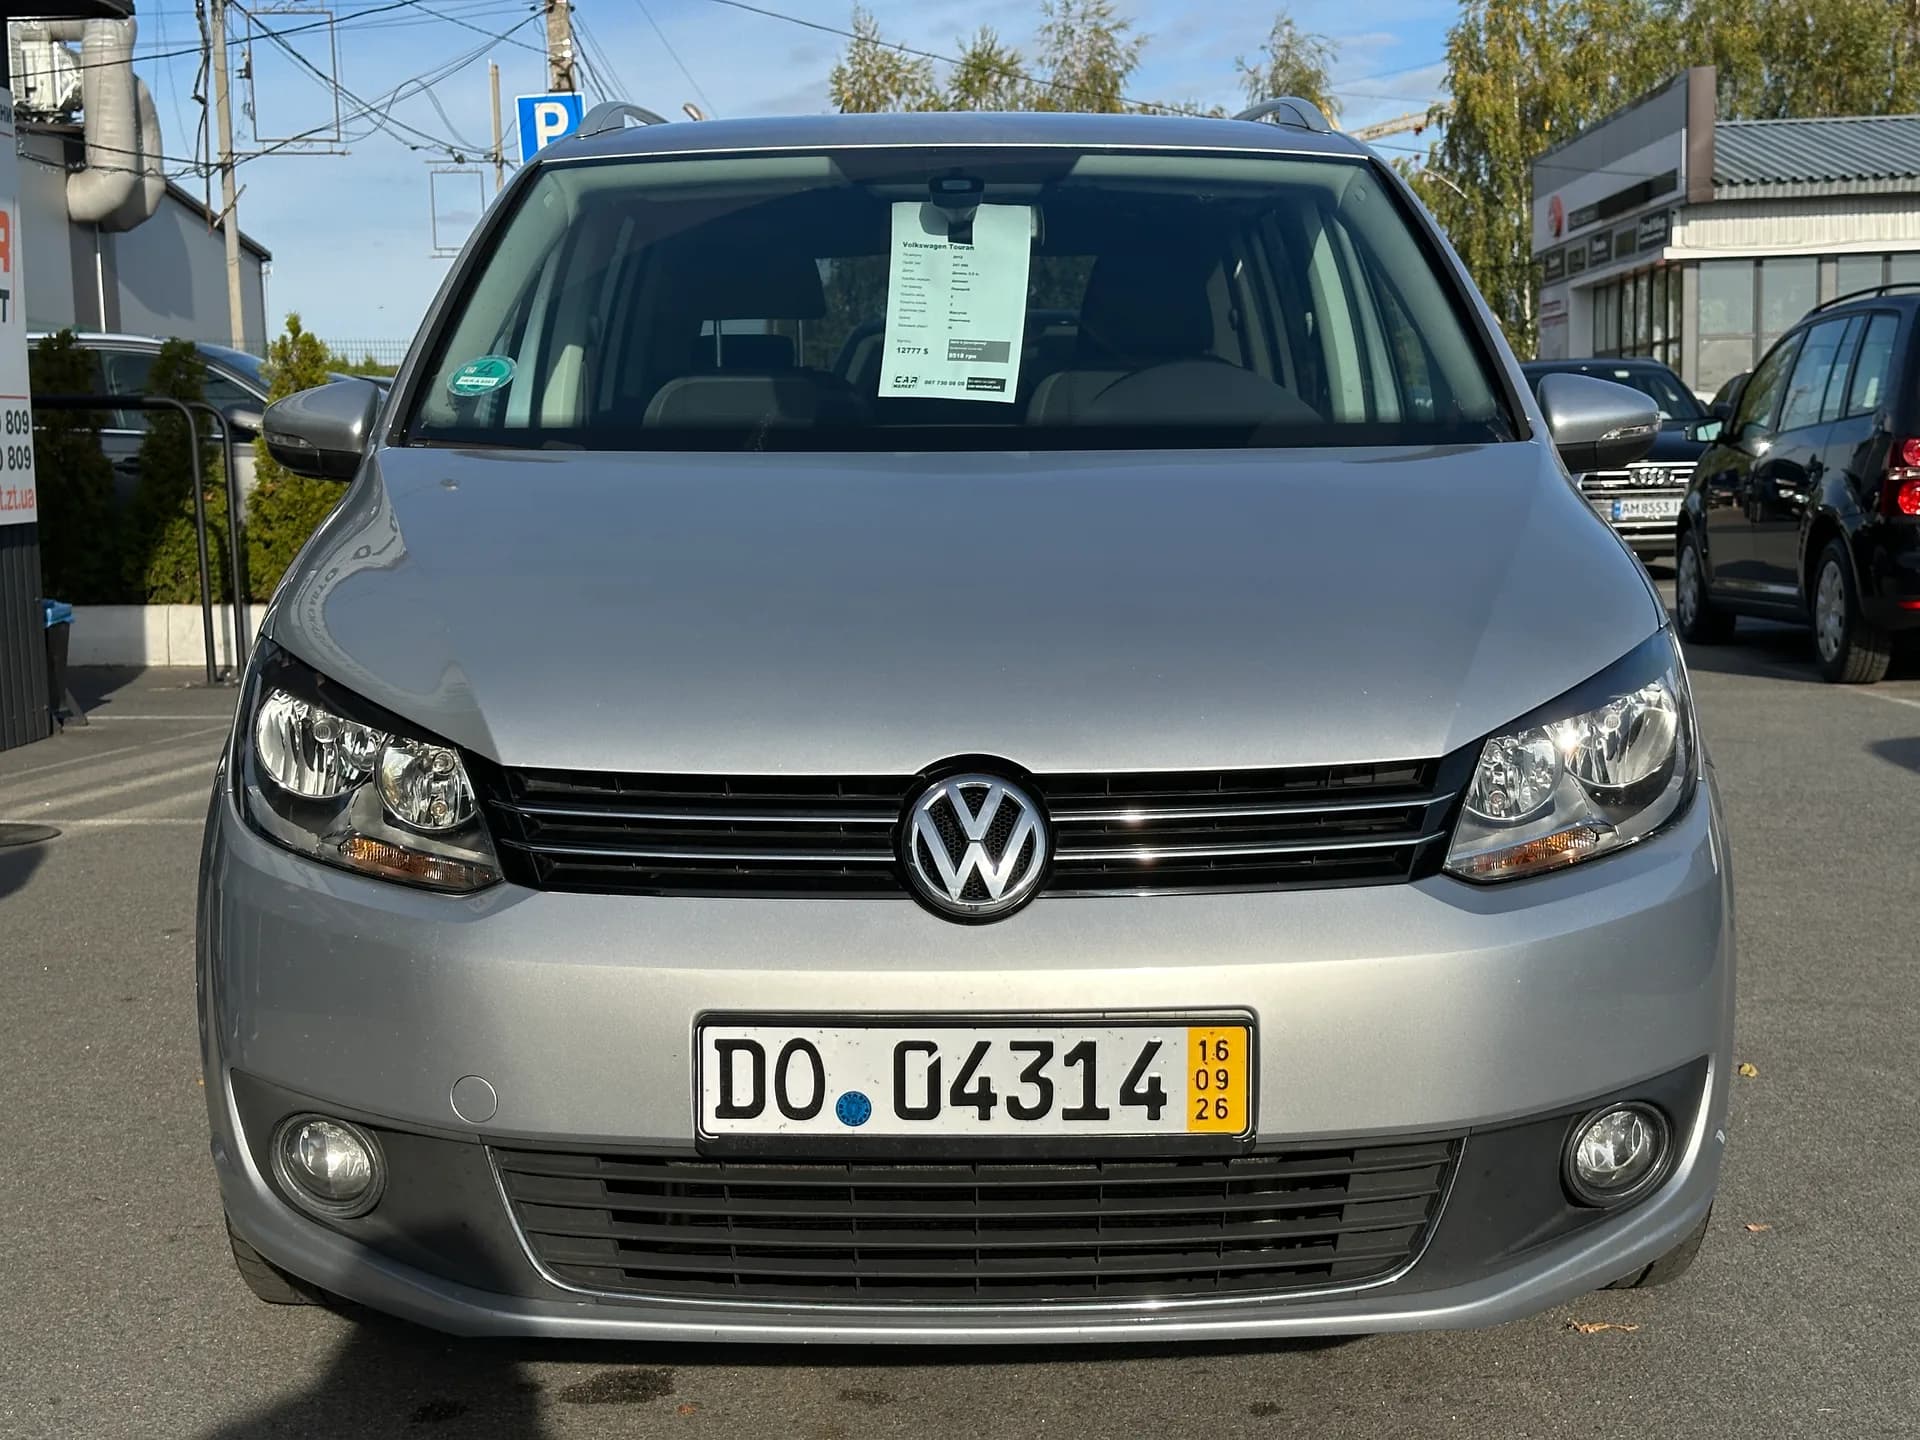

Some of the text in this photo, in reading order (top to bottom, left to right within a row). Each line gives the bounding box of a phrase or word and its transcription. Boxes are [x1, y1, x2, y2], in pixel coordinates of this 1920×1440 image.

[534, 102, 569, 151] P
[902, 241, 975, 251] Volkswagen Touran
[895, 376, 918, 384] CAR
[6, 410, 30, 434] 809
[8, 445, 31, 470] 809
[1199, 1040, 1229, 1061] 16
[715, 1038, 1167, 1120] DO 04314
[1196, 1069, 1229, 1091] 09
[1196, 1098, 1229, 1120] 26
